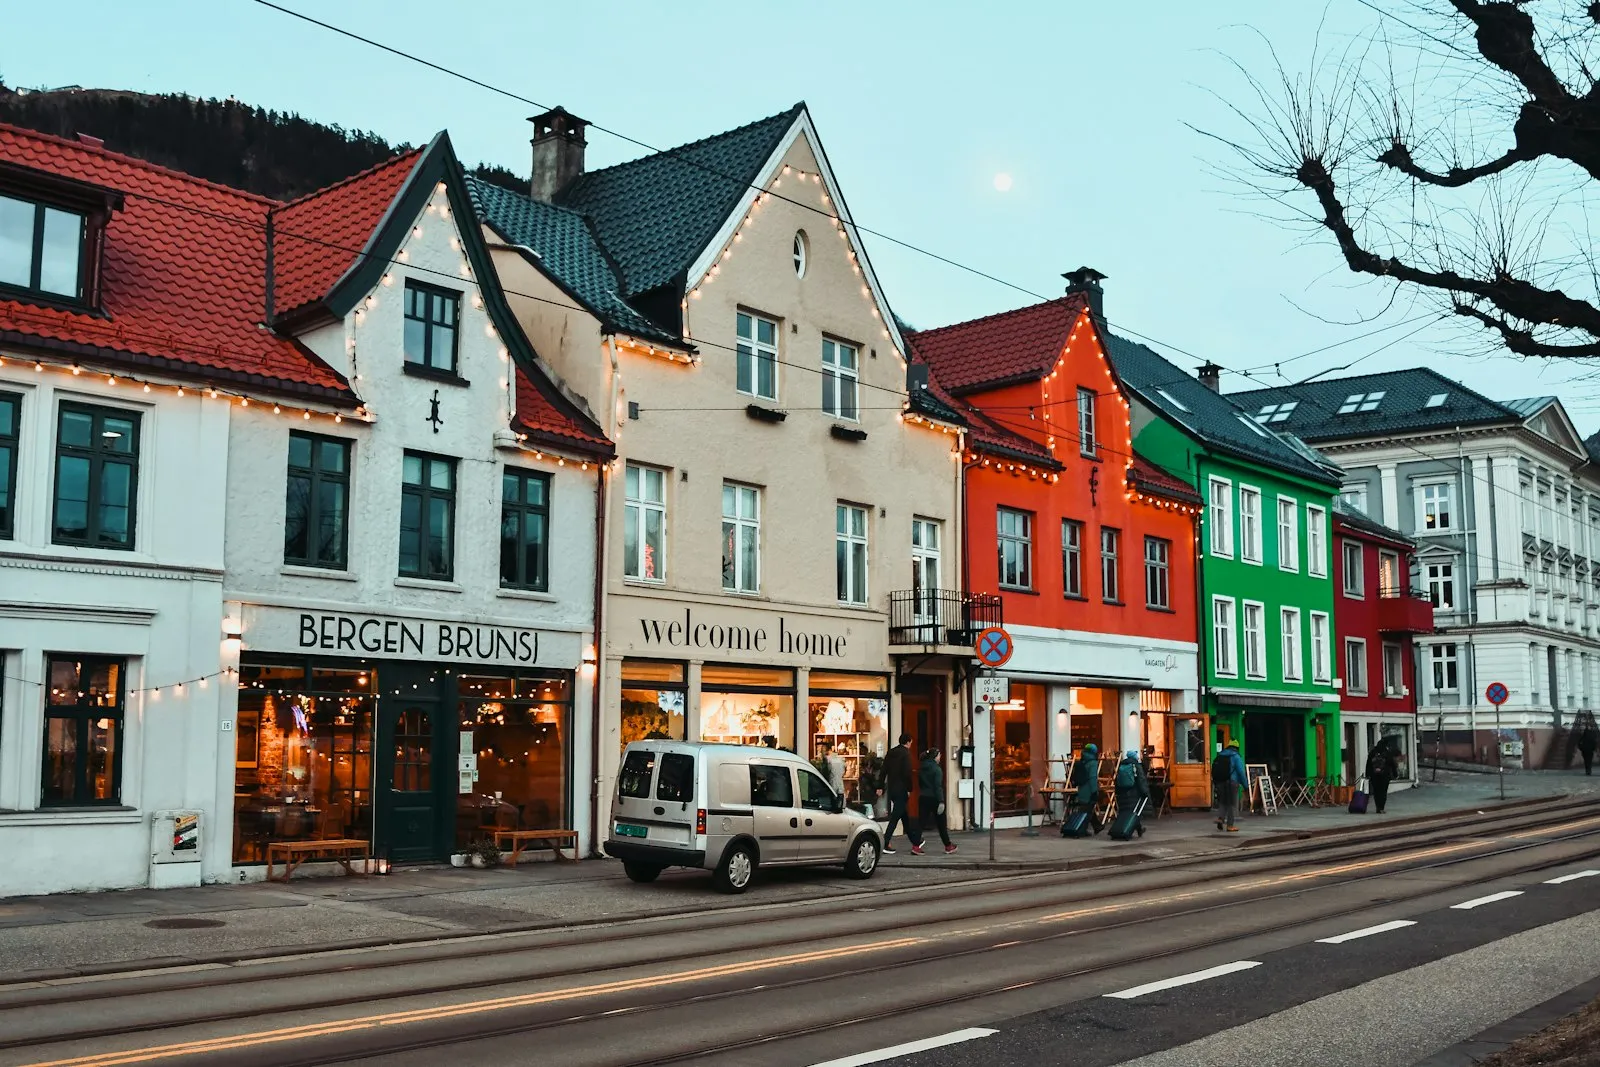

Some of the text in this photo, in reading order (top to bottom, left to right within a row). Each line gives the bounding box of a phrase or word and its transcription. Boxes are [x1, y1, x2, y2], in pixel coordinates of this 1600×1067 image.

[299, 613, 539, 664] BERGEN BRUNSJ
[639, 608, 847, 657] welcome home
